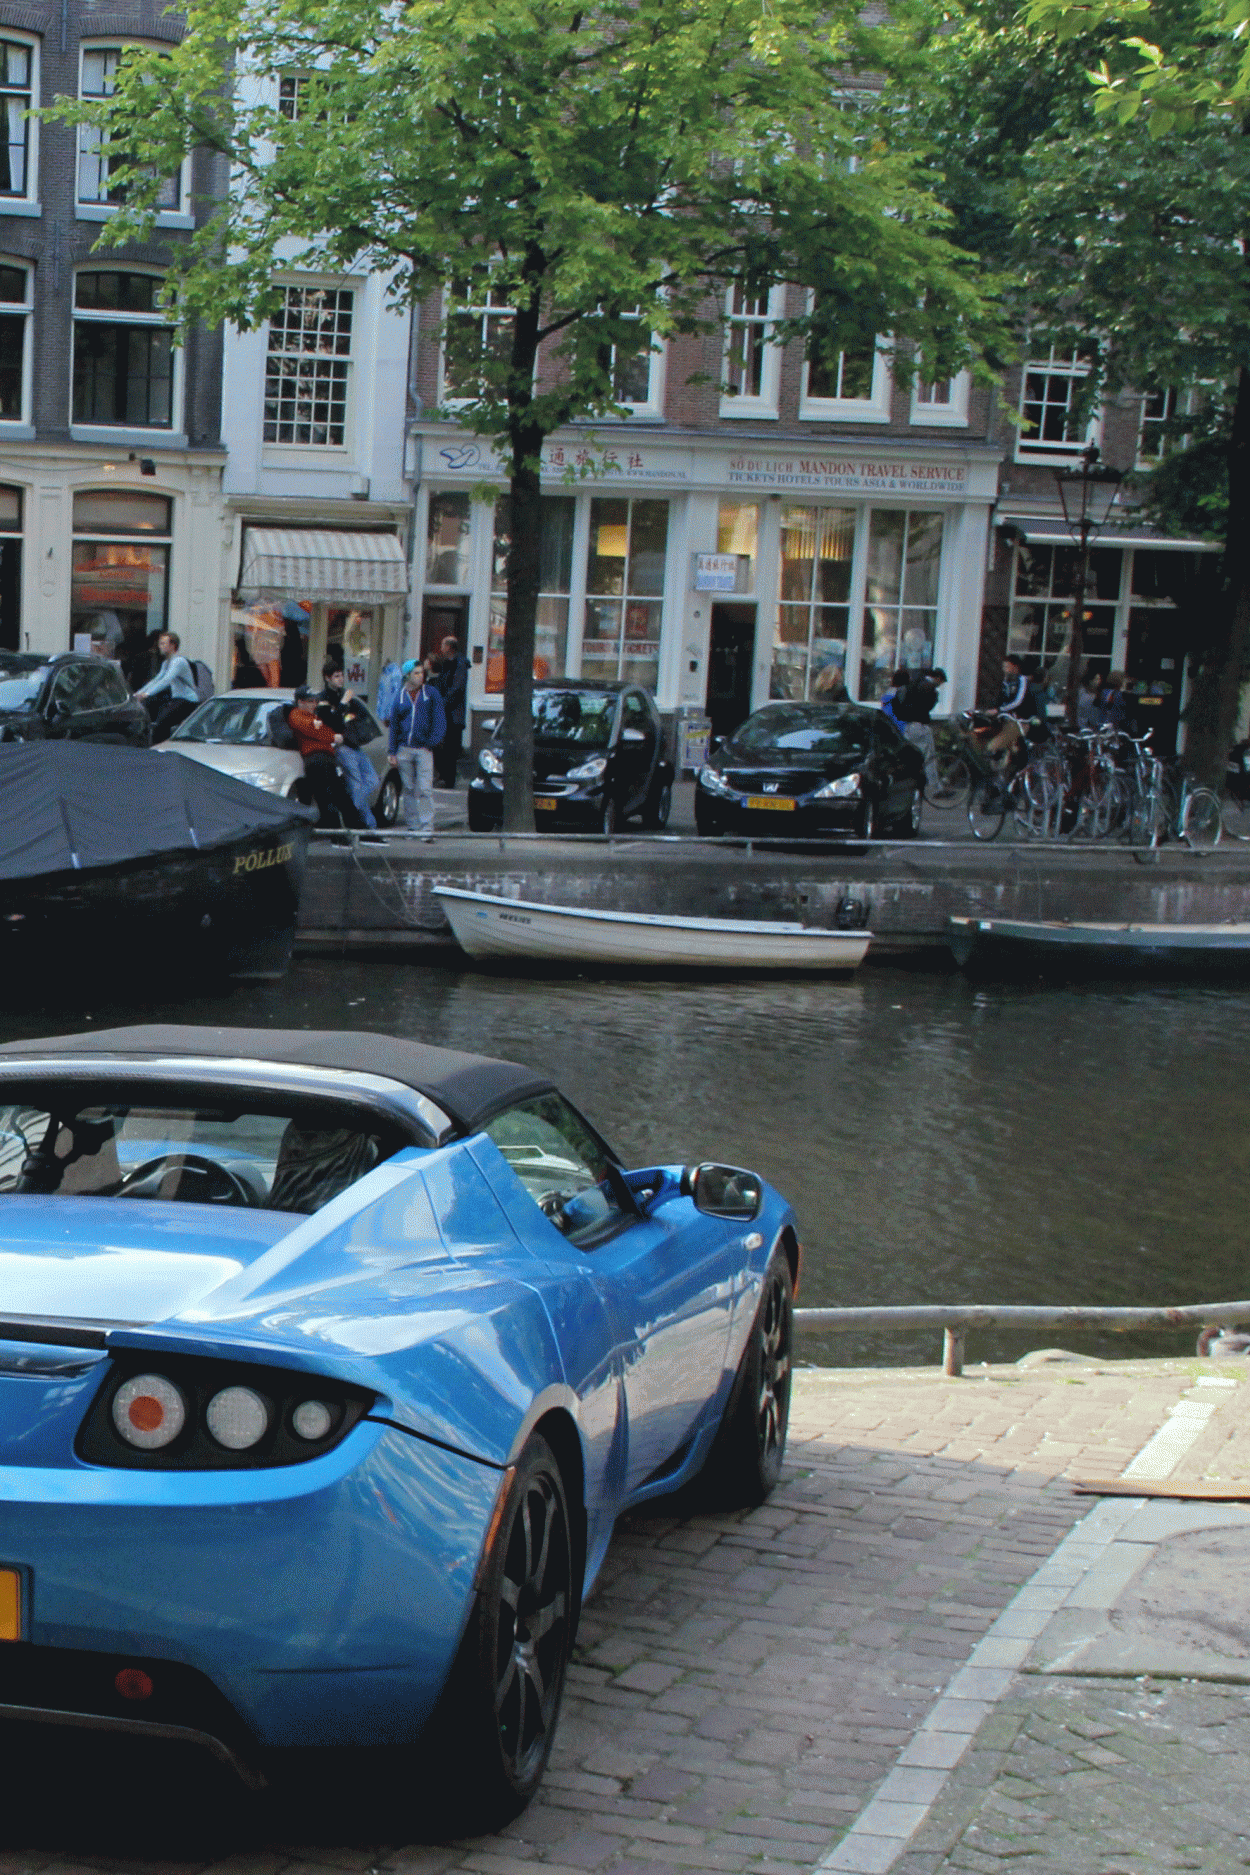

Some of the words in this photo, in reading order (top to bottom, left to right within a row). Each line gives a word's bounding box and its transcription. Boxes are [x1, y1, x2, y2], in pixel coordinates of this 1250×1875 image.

[549, 447, 644, 469] 通旅行社
[729, 471, 775, 483] TICKETS
[777, 473, 820, 485] HOTELS
[824, 475, 859, 486] TOURS
[863, 477, 886, 488] ASIA
[888, 479, 896, 489] &
[899, 479, 965, 491] WORLDWIDE
[799, 461, 855, 475] MANDON
[860, 464, 908, 478] TRAVEL
[910, 466, 965, 481] SERVICE
[232, 842, 295, 875] POLLUX
